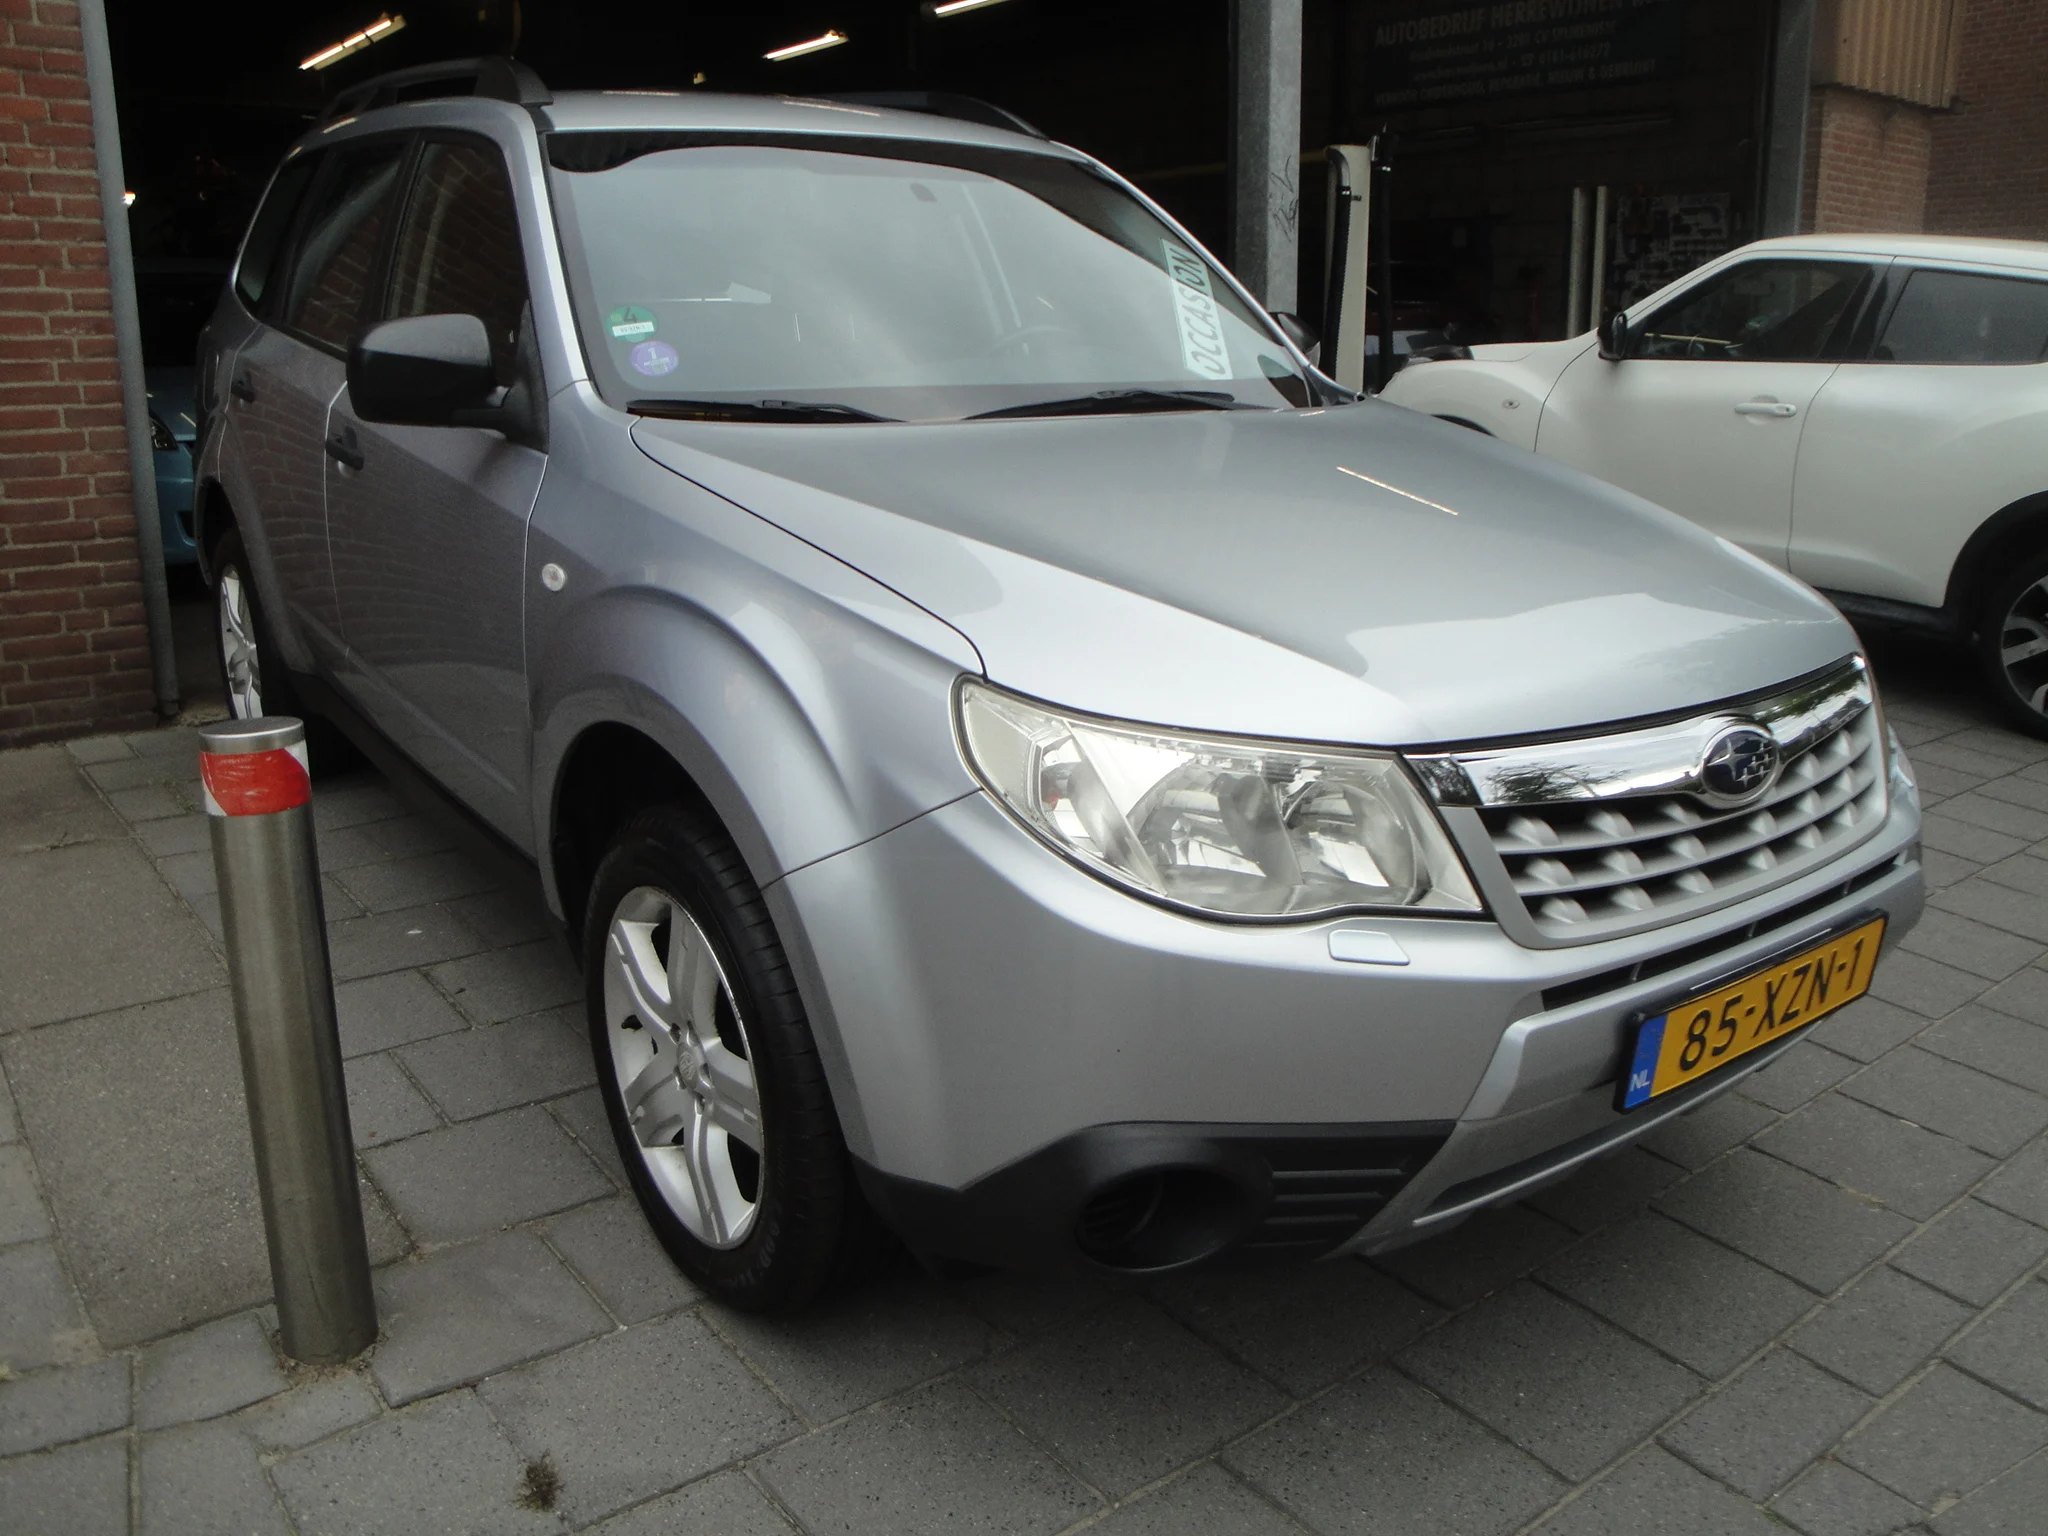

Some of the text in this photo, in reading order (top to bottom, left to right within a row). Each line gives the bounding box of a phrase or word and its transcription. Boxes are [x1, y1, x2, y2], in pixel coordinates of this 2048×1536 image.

[1375, 8, 1485, 47] AUTOBEDRIJF
[623, 306, 638, 323] 4
[1168, 247, 1226, 375] OCCASION
[1678, 936, 1865, 1072] 85-XZN-1
[1629, 1068, 1651, 1093] NL
